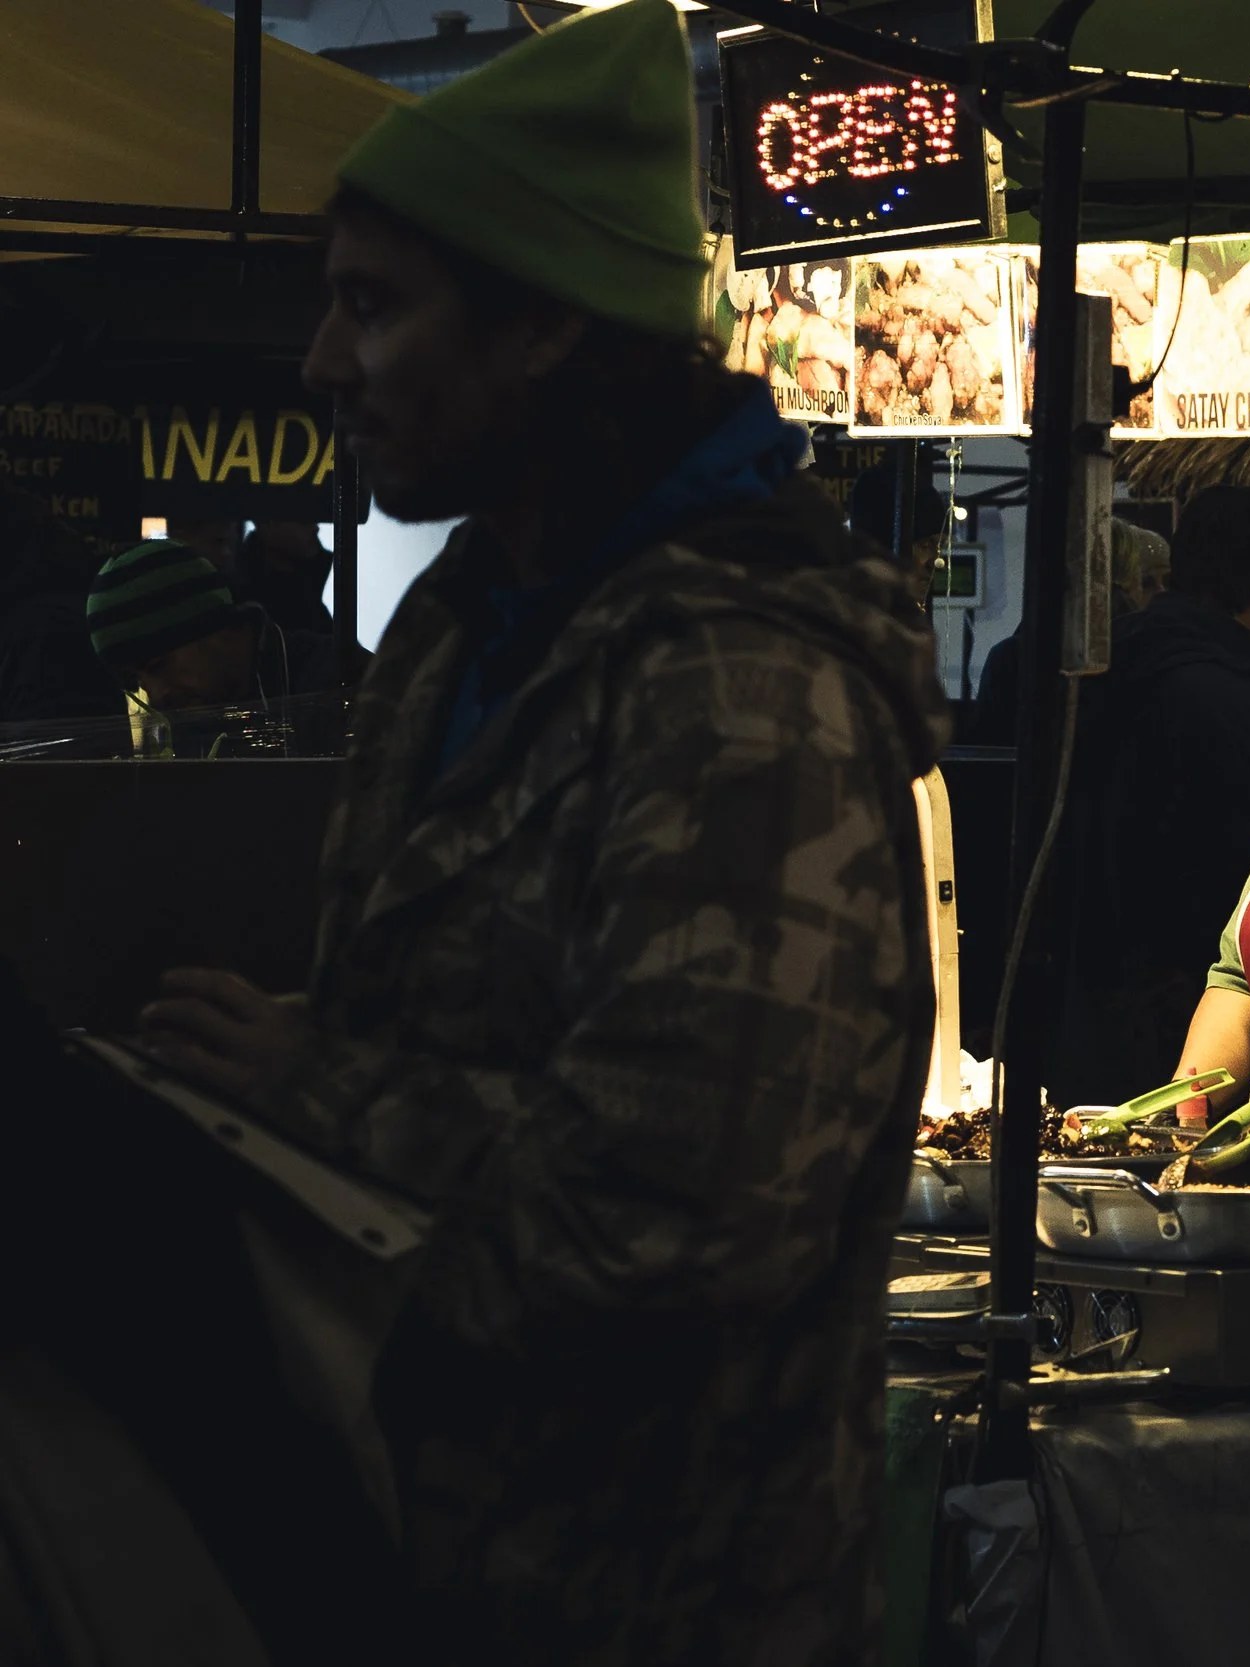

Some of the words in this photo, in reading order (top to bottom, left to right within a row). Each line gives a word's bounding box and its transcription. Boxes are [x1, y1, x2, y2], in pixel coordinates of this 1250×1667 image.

[757, 81, 959, 191] OPEN
[770, 385, 784, 409] TH
[1176, 392, 1230, 429] SATAY
[0, 405, 132, 445] MPANADA
[893, 414, 923, 426] Chicken
[134, 404, 335, 486] NAD
